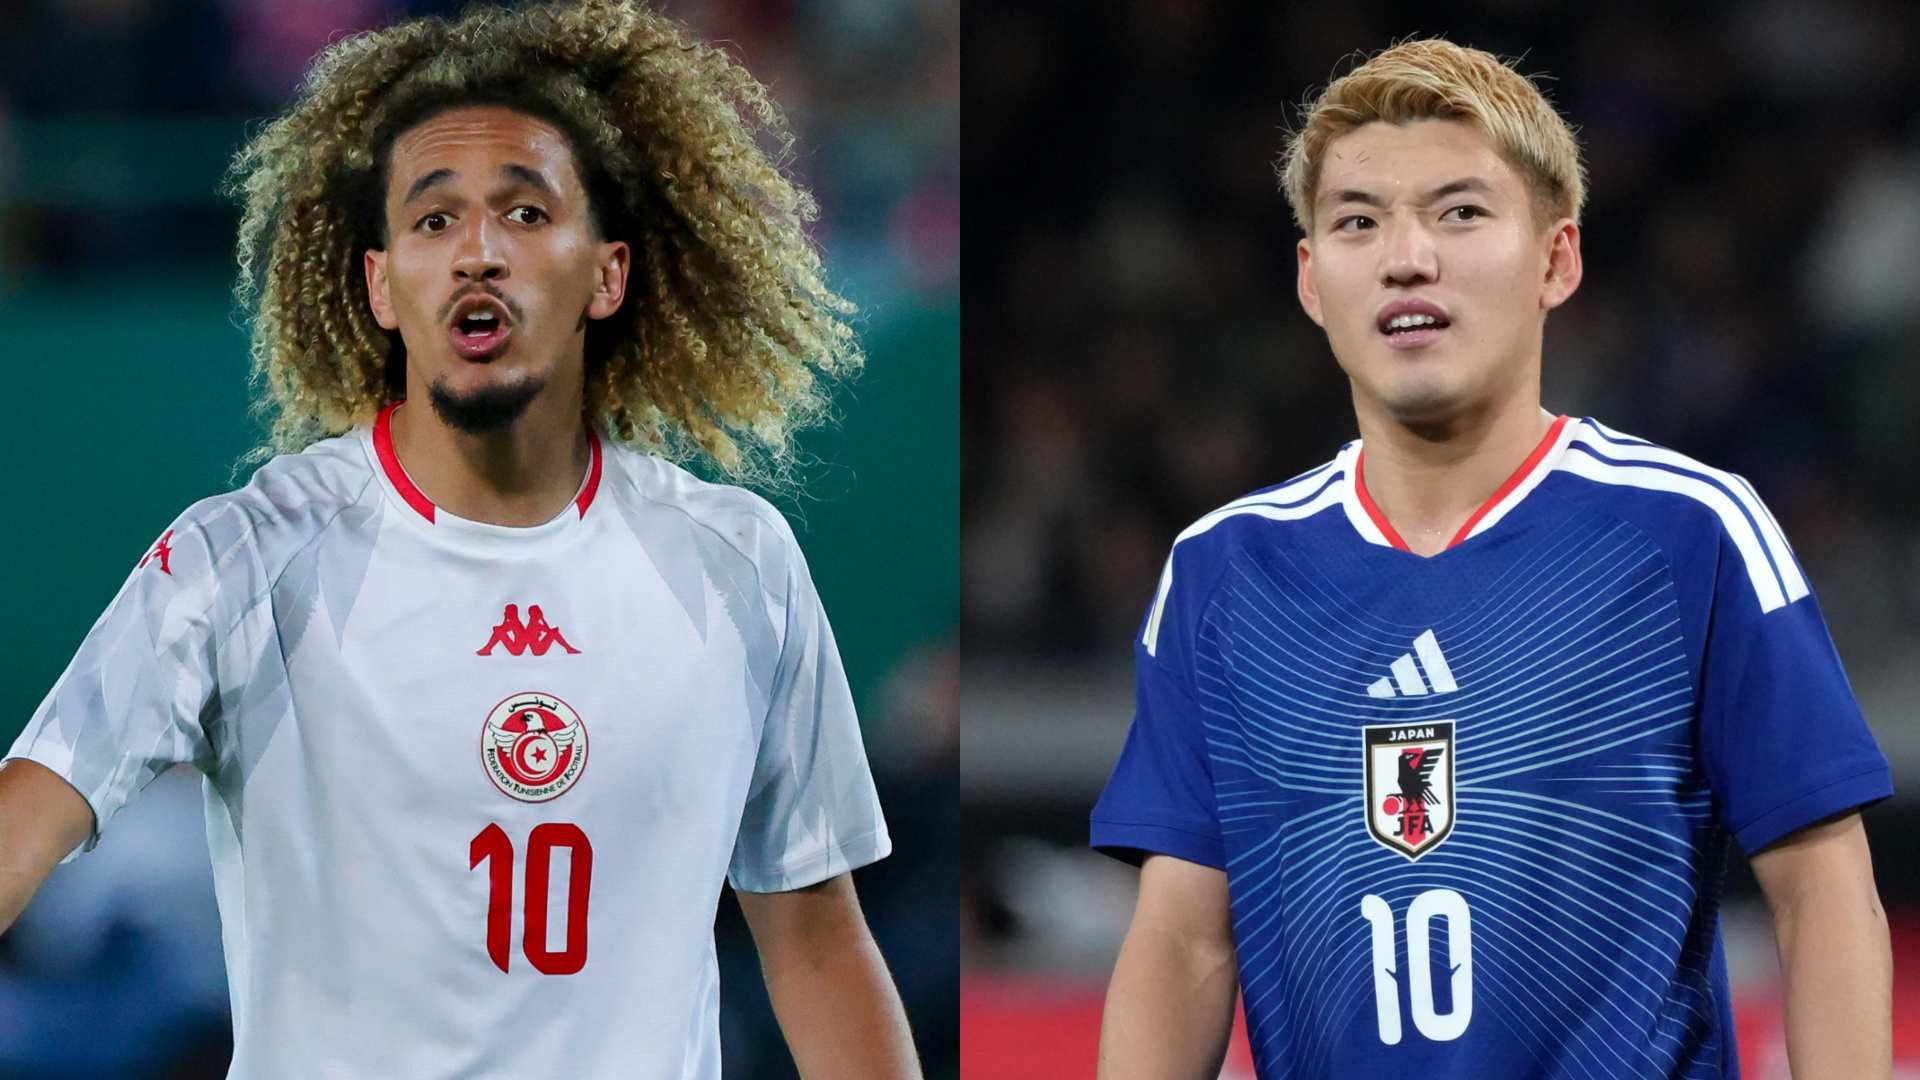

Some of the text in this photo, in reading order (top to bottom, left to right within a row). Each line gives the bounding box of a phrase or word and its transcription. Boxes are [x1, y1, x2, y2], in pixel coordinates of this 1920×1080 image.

[1388, 727, 1435, 741] JAPAN
[1393, 815, 1434, 836] JFA
[469, 822, 593, 975] 10
[1360, 888, 1473, 1046] 10
